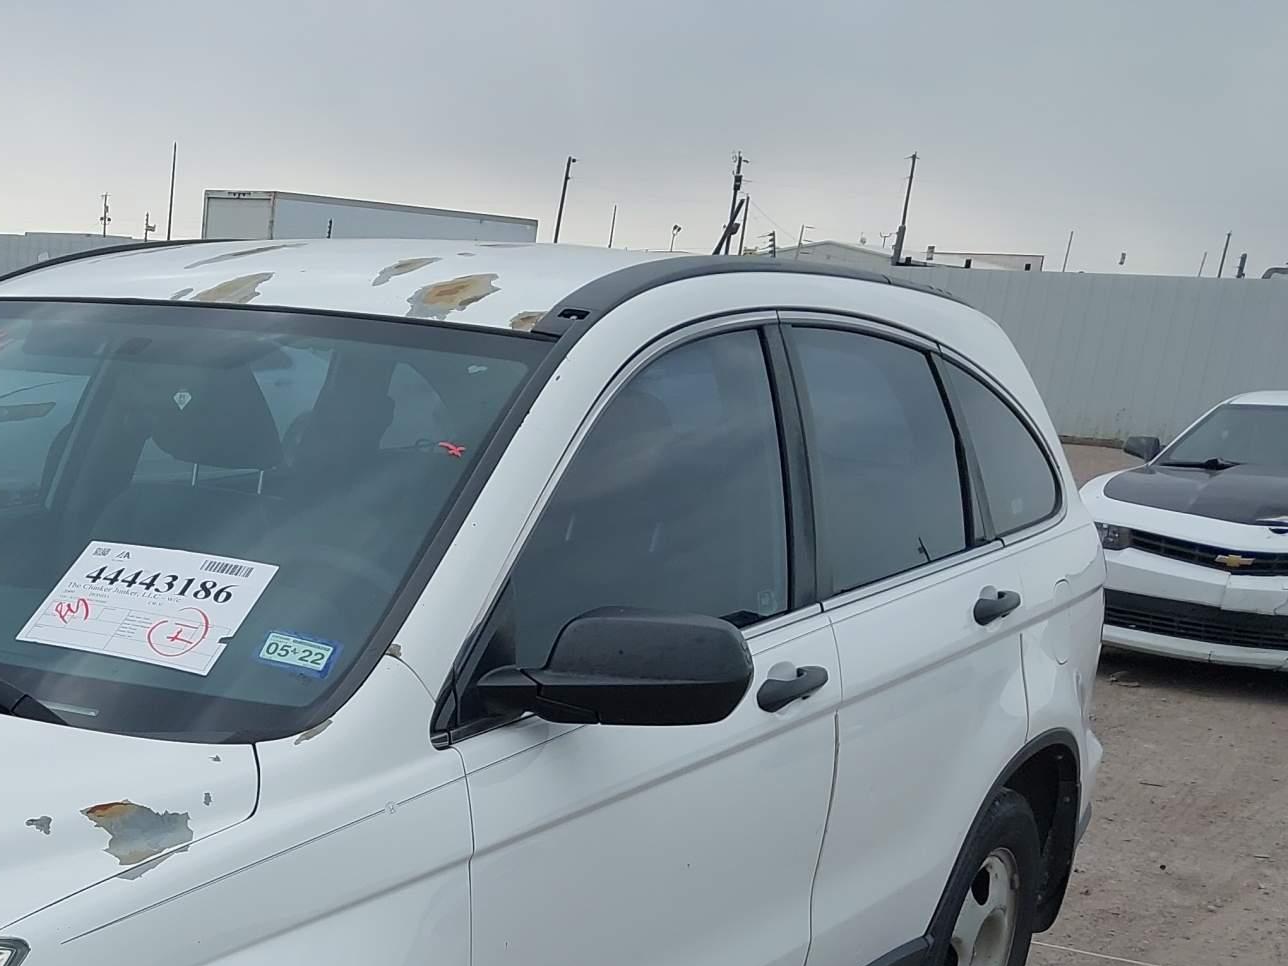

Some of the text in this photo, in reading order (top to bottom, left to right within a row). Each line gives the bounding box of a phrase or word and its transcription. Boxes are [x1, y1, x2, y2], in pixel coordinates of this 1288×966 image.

[86, 565, 240, 604] 44443186
[265, 642, 292, 658] 05
[297, 649, 326, 666] 22
